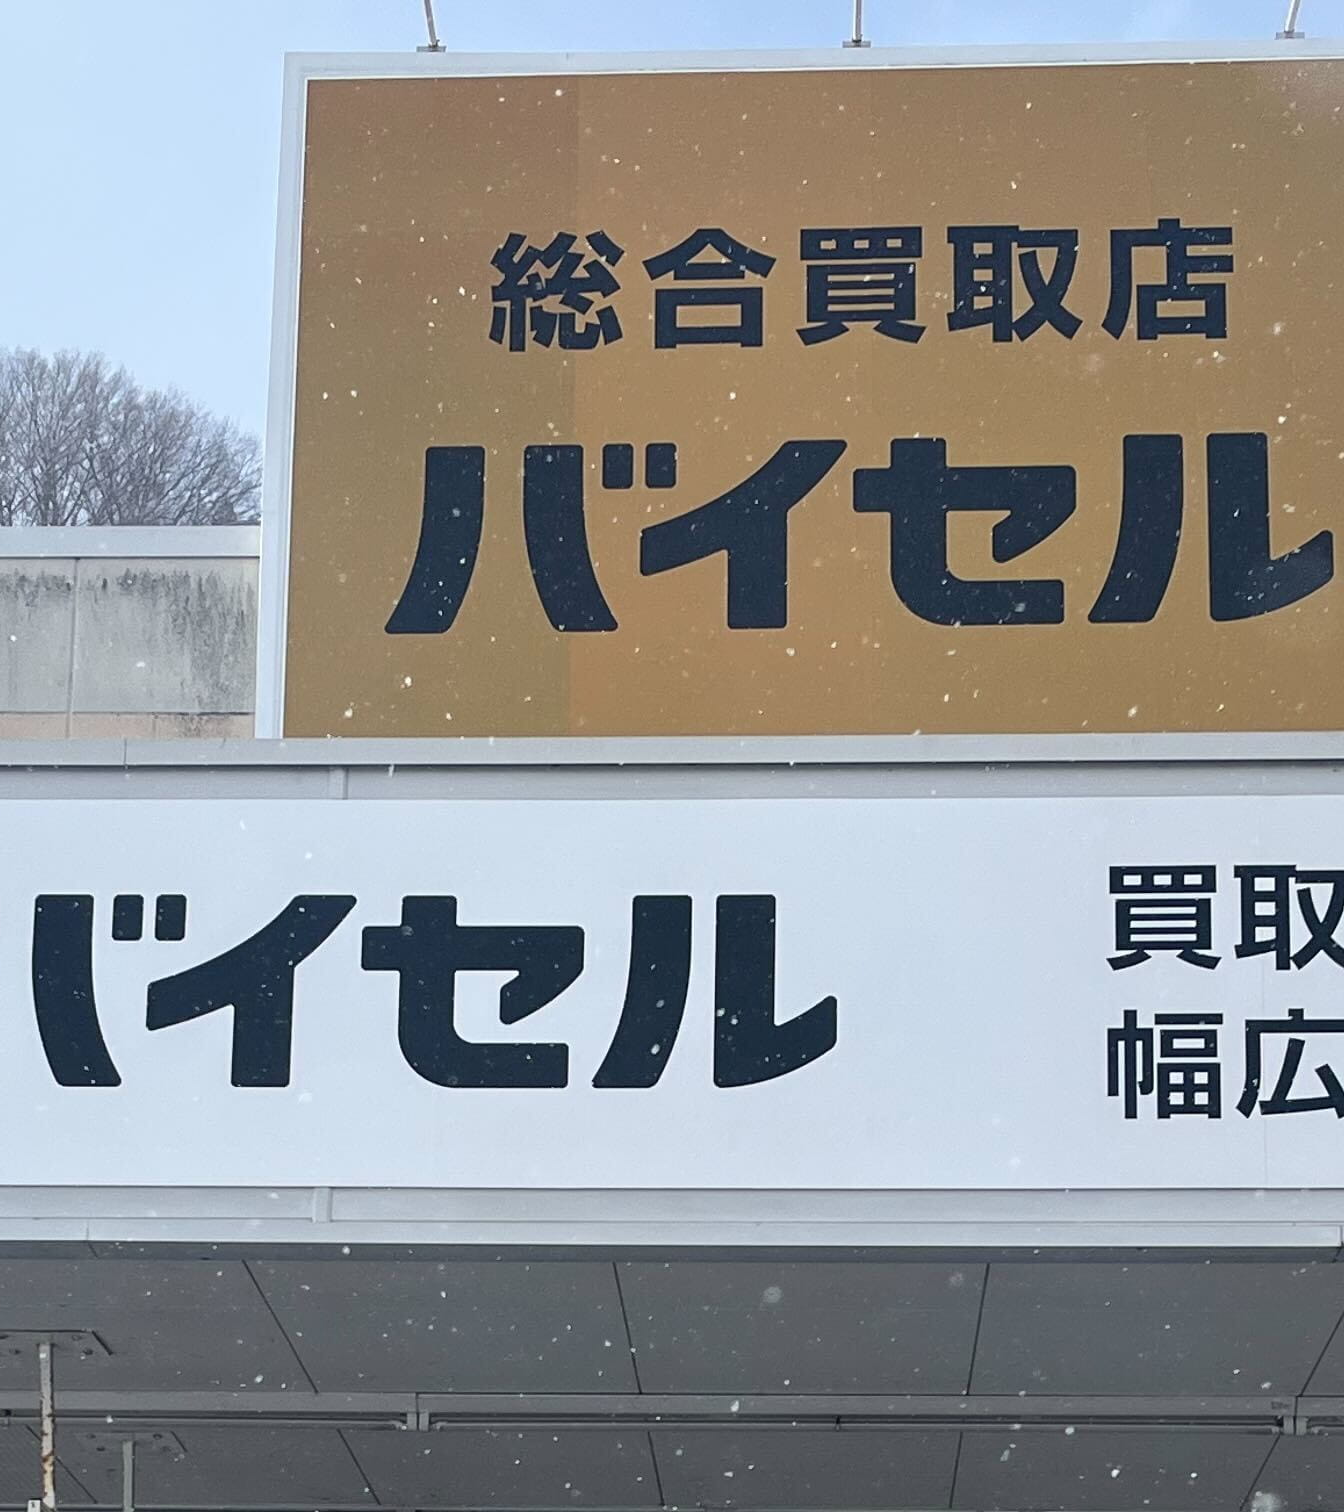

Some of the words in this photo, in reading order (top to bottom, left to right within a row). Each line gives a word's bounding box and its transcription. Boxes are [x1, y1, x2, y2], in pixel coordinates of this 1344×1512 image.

[490, 217, 1236, 352] 総合買取店
[385, 432, 1334, 634] バイセル
